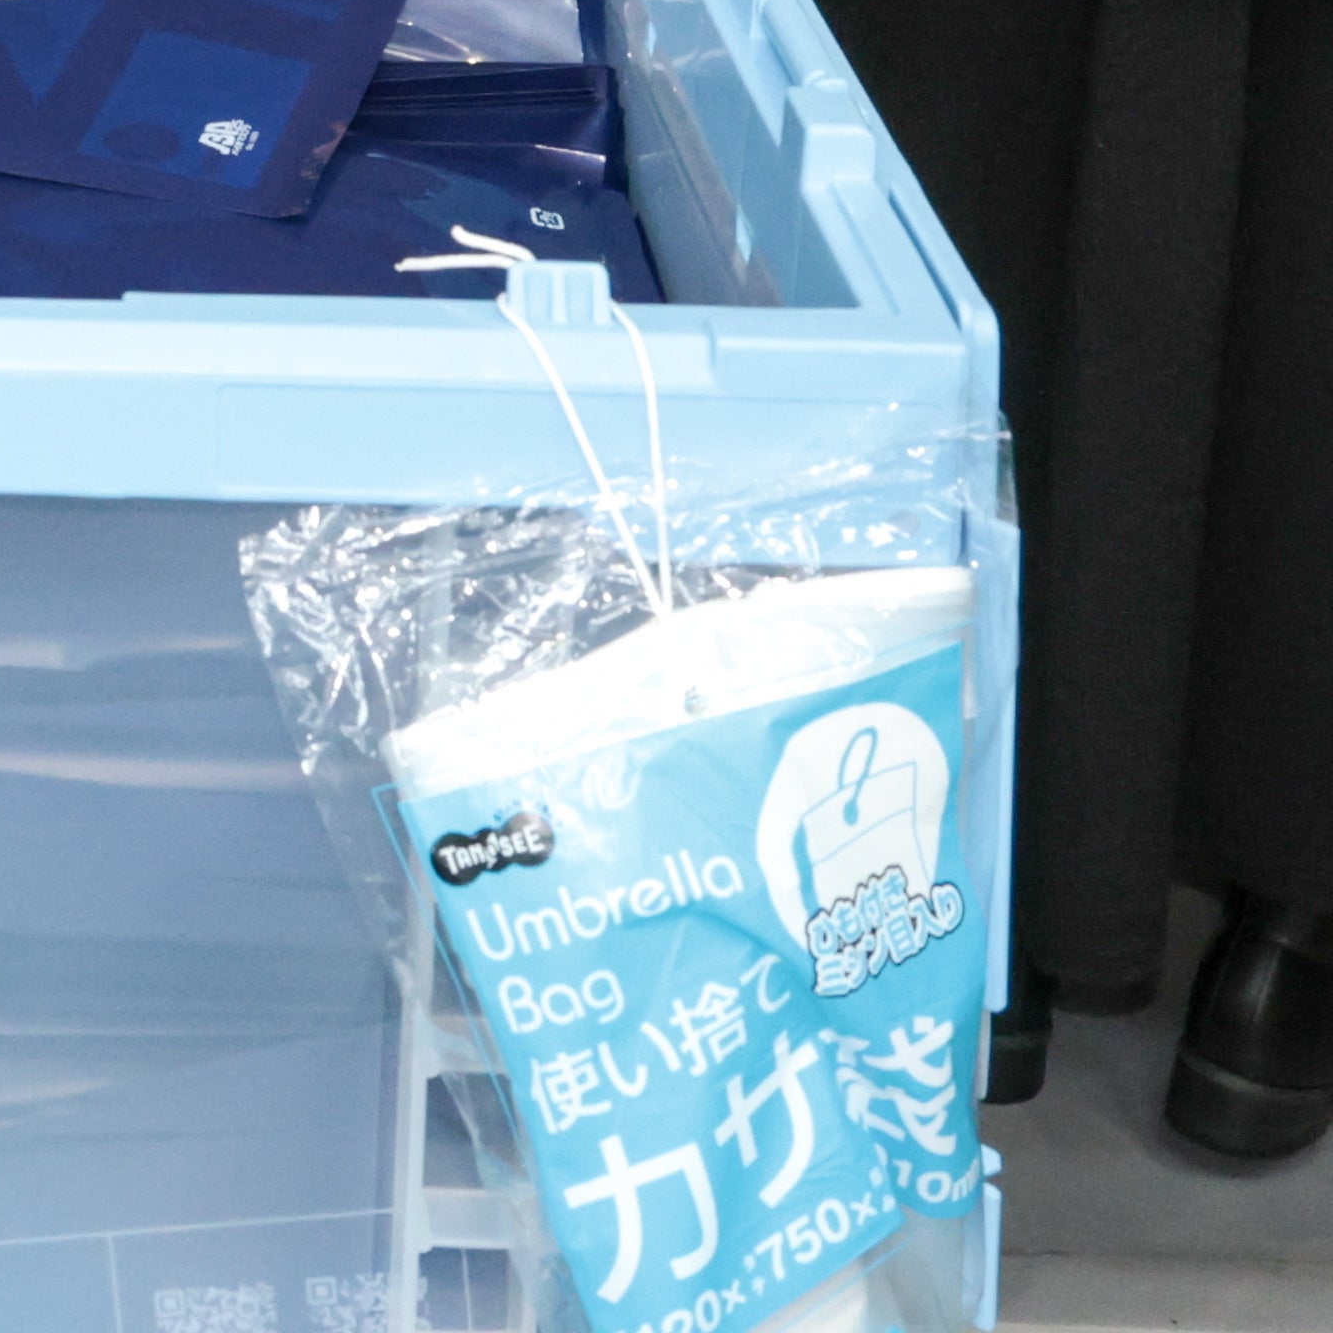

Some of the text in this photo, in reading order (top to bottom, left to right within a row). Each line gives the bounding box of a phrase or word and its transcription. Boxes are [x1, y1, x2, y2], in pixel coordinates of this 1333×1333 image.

[466, 849, 745, 962] Umbrella
[496, 968, 626, 1035] Bag
[530, 954, 792, 1133] 使い捨て
[562, 1015, 956, 1305] カサ袋
